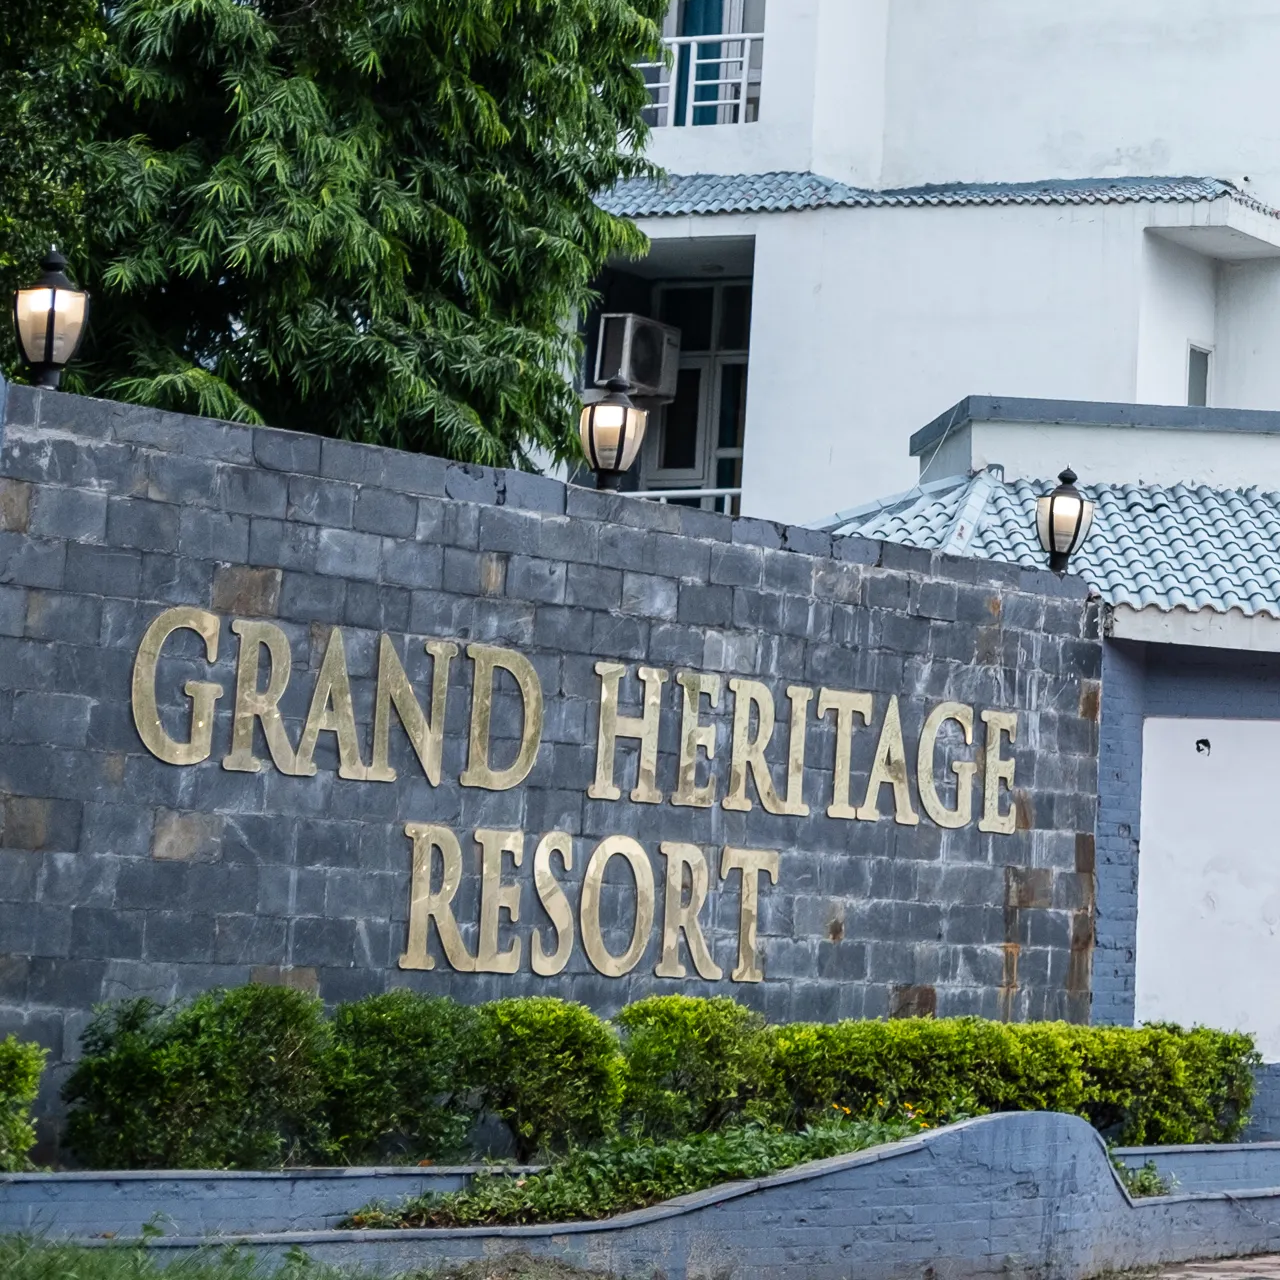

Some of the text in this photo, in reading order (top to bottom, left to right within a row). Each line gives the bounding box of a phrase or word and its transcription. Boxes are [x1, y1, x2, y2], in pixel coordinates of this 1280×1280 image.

[131, 606, 1018, 835] GRAND HERITAGE
[399, 822, 779, 983] RESORT
